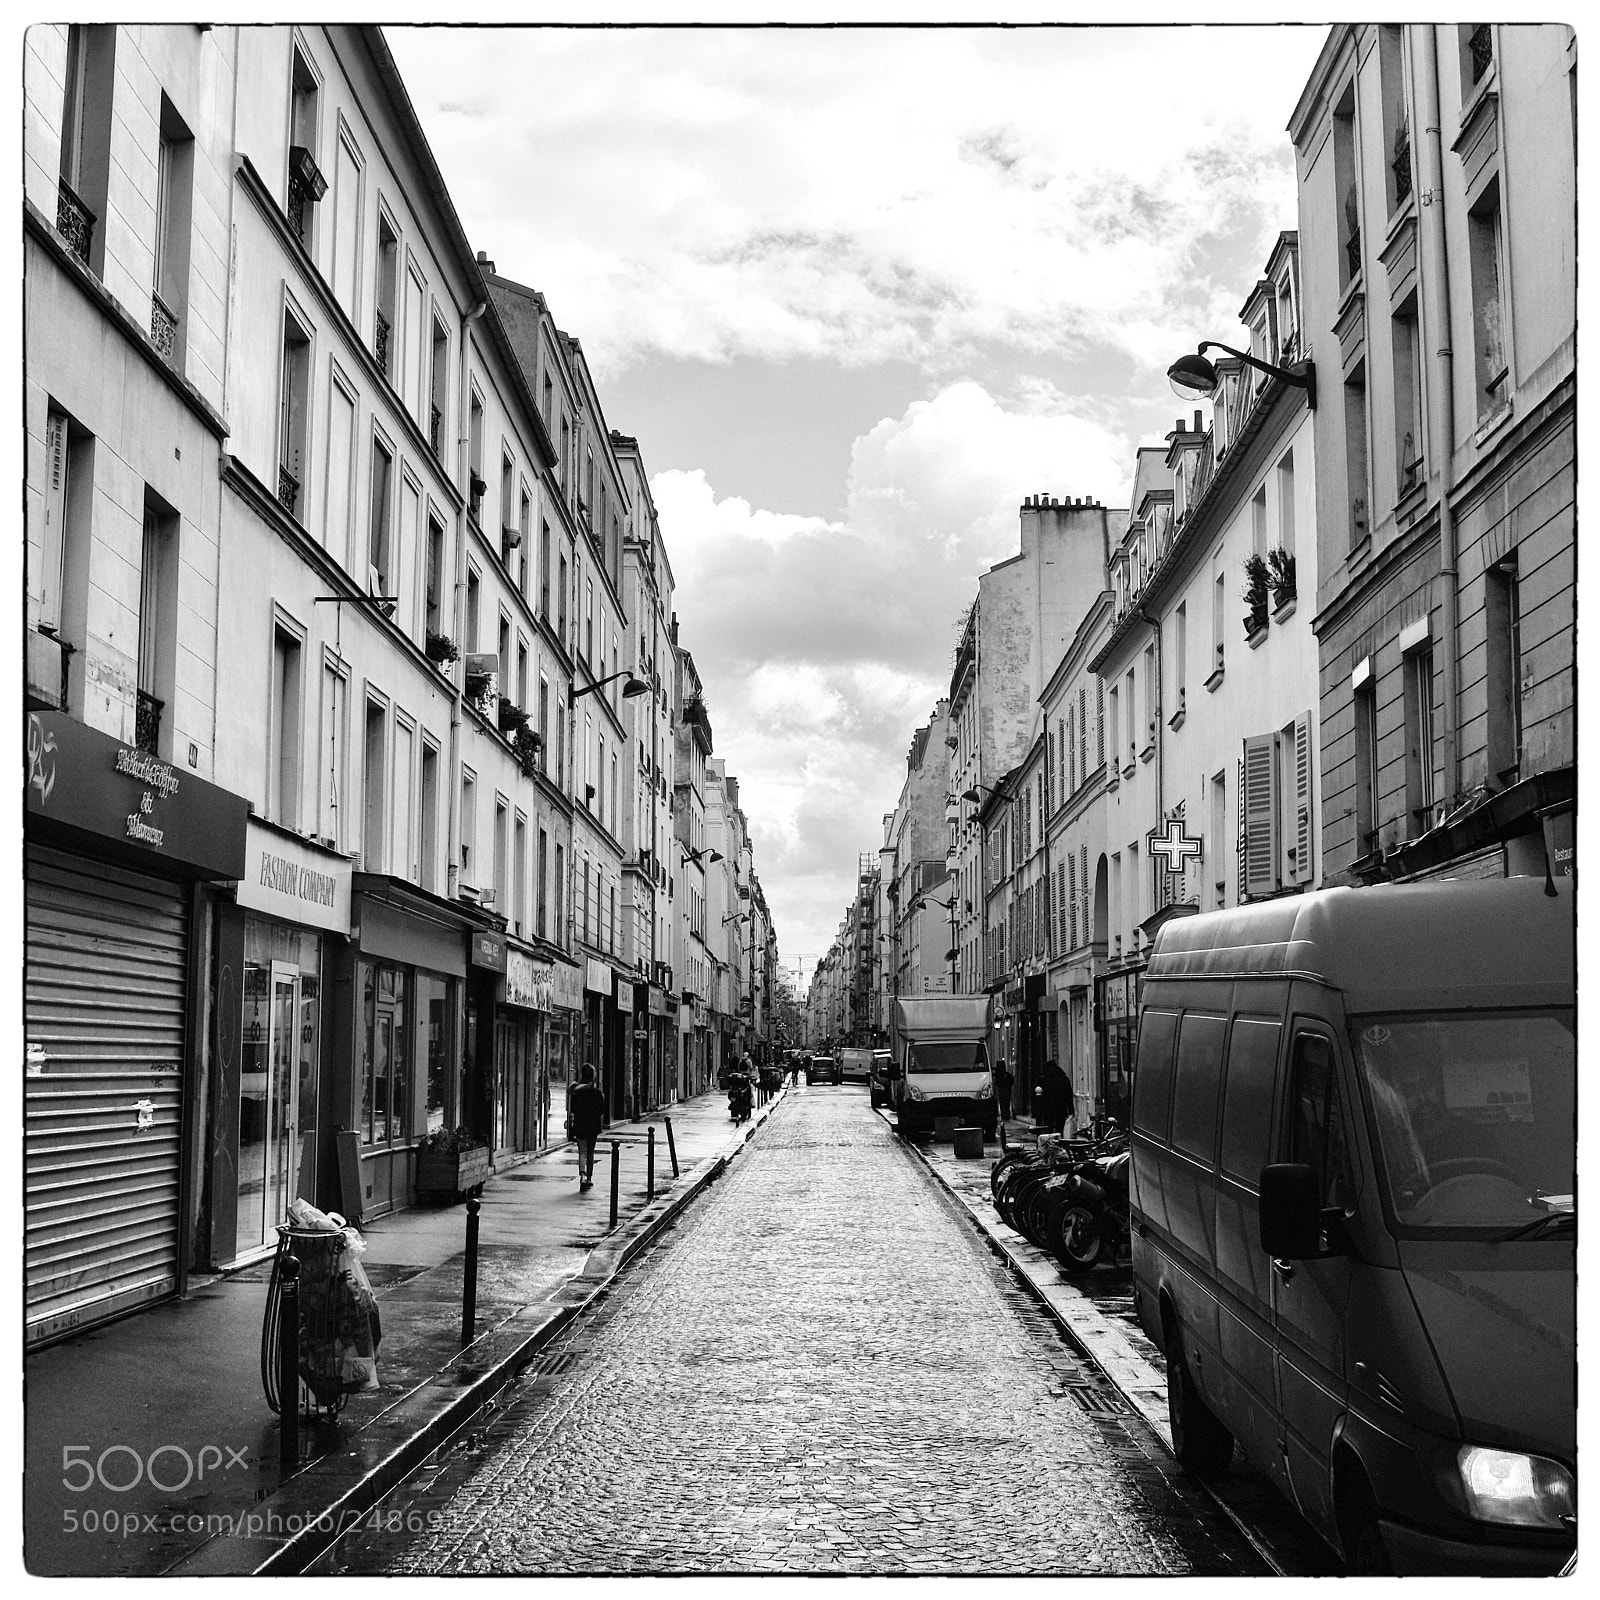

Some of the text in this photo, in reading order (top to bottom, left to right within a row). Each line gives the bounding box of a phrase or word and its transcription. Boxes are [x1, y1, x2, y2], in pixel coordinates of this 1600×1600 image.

[260, 851, 337, 908] FASHION COMPANY
[303, 1024, 312, 1044] CO
